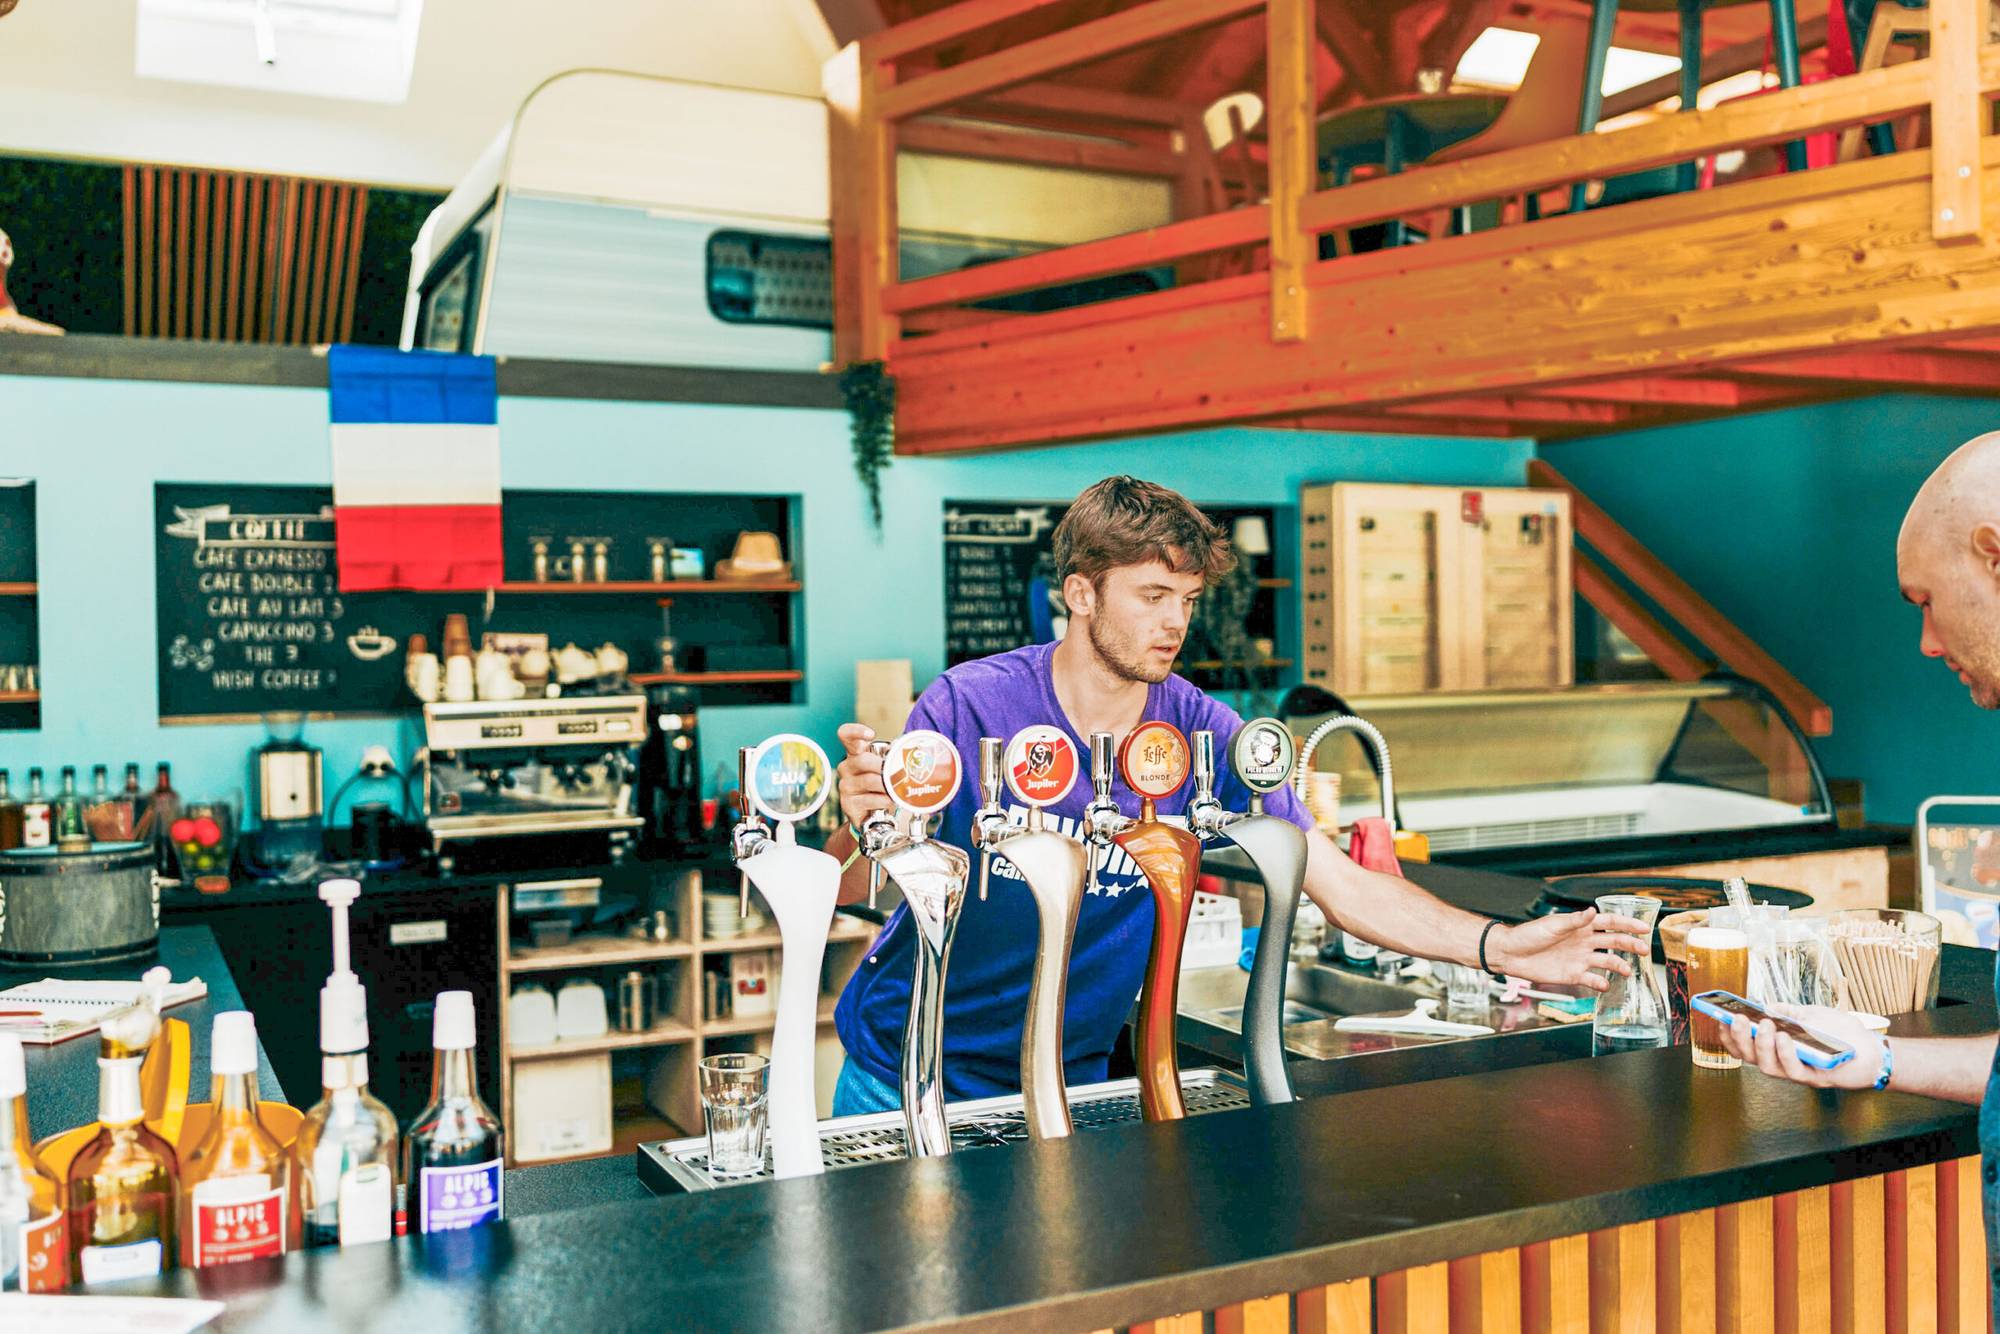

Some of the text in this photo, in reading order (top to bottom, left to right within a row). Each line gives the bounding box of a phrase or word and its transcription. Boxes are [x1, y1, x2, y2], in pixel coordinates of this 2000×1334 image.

[1143, 744, 1168, 766] Leffe
[771, 771, 798, 785] EAU
[1026, 778, 1060, 791] Jupiler
[1140, 774, 1171, 782] BLONDE
[905, 783, 943, 798] Jupiler
